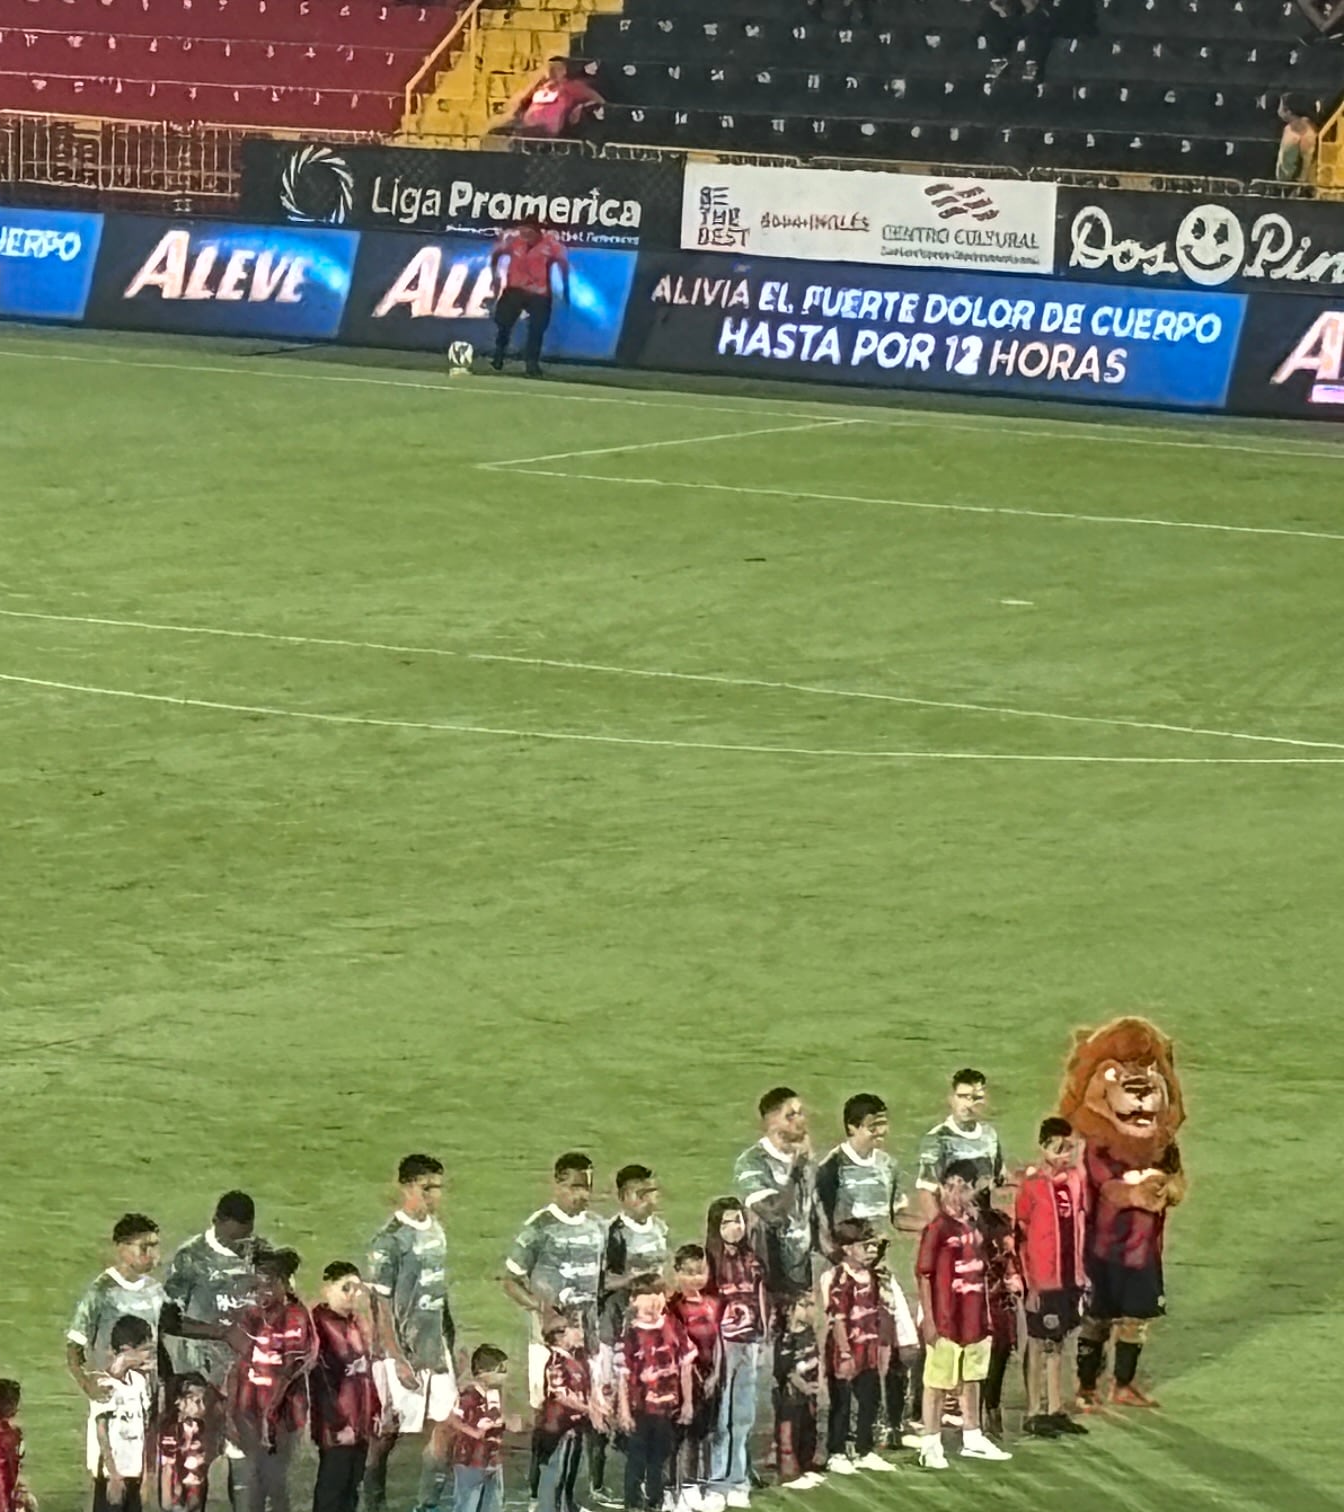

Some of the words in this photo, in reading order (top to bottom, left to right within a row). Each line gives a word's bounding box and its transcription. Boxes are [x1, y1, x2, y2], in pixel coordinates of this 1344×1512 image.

[370, 175, 441, 224] Liga
[447, 180, 643, 229] Promerica
[123, 229, 309, 303] ALEVE
[1069, 205, 1179, 276] Dos
[370, 245, 510, 319] ALE
[651, 274, 750, 310] ALIVIA
[758, 280, 794, 316] EL
[799, 284, 921, 324] FUERTE
[922, 292, 1037, 332] DOLOR
[1039, 301, 1087, 335] DE
[1090, 305, 1223, 344] CUERPO
[717, 315, 842, 366] HASTA
[850, 329, 936, 371] POR
[945, 334, 984, 376] 12
[988, 338, 1129, 384] HORAS
